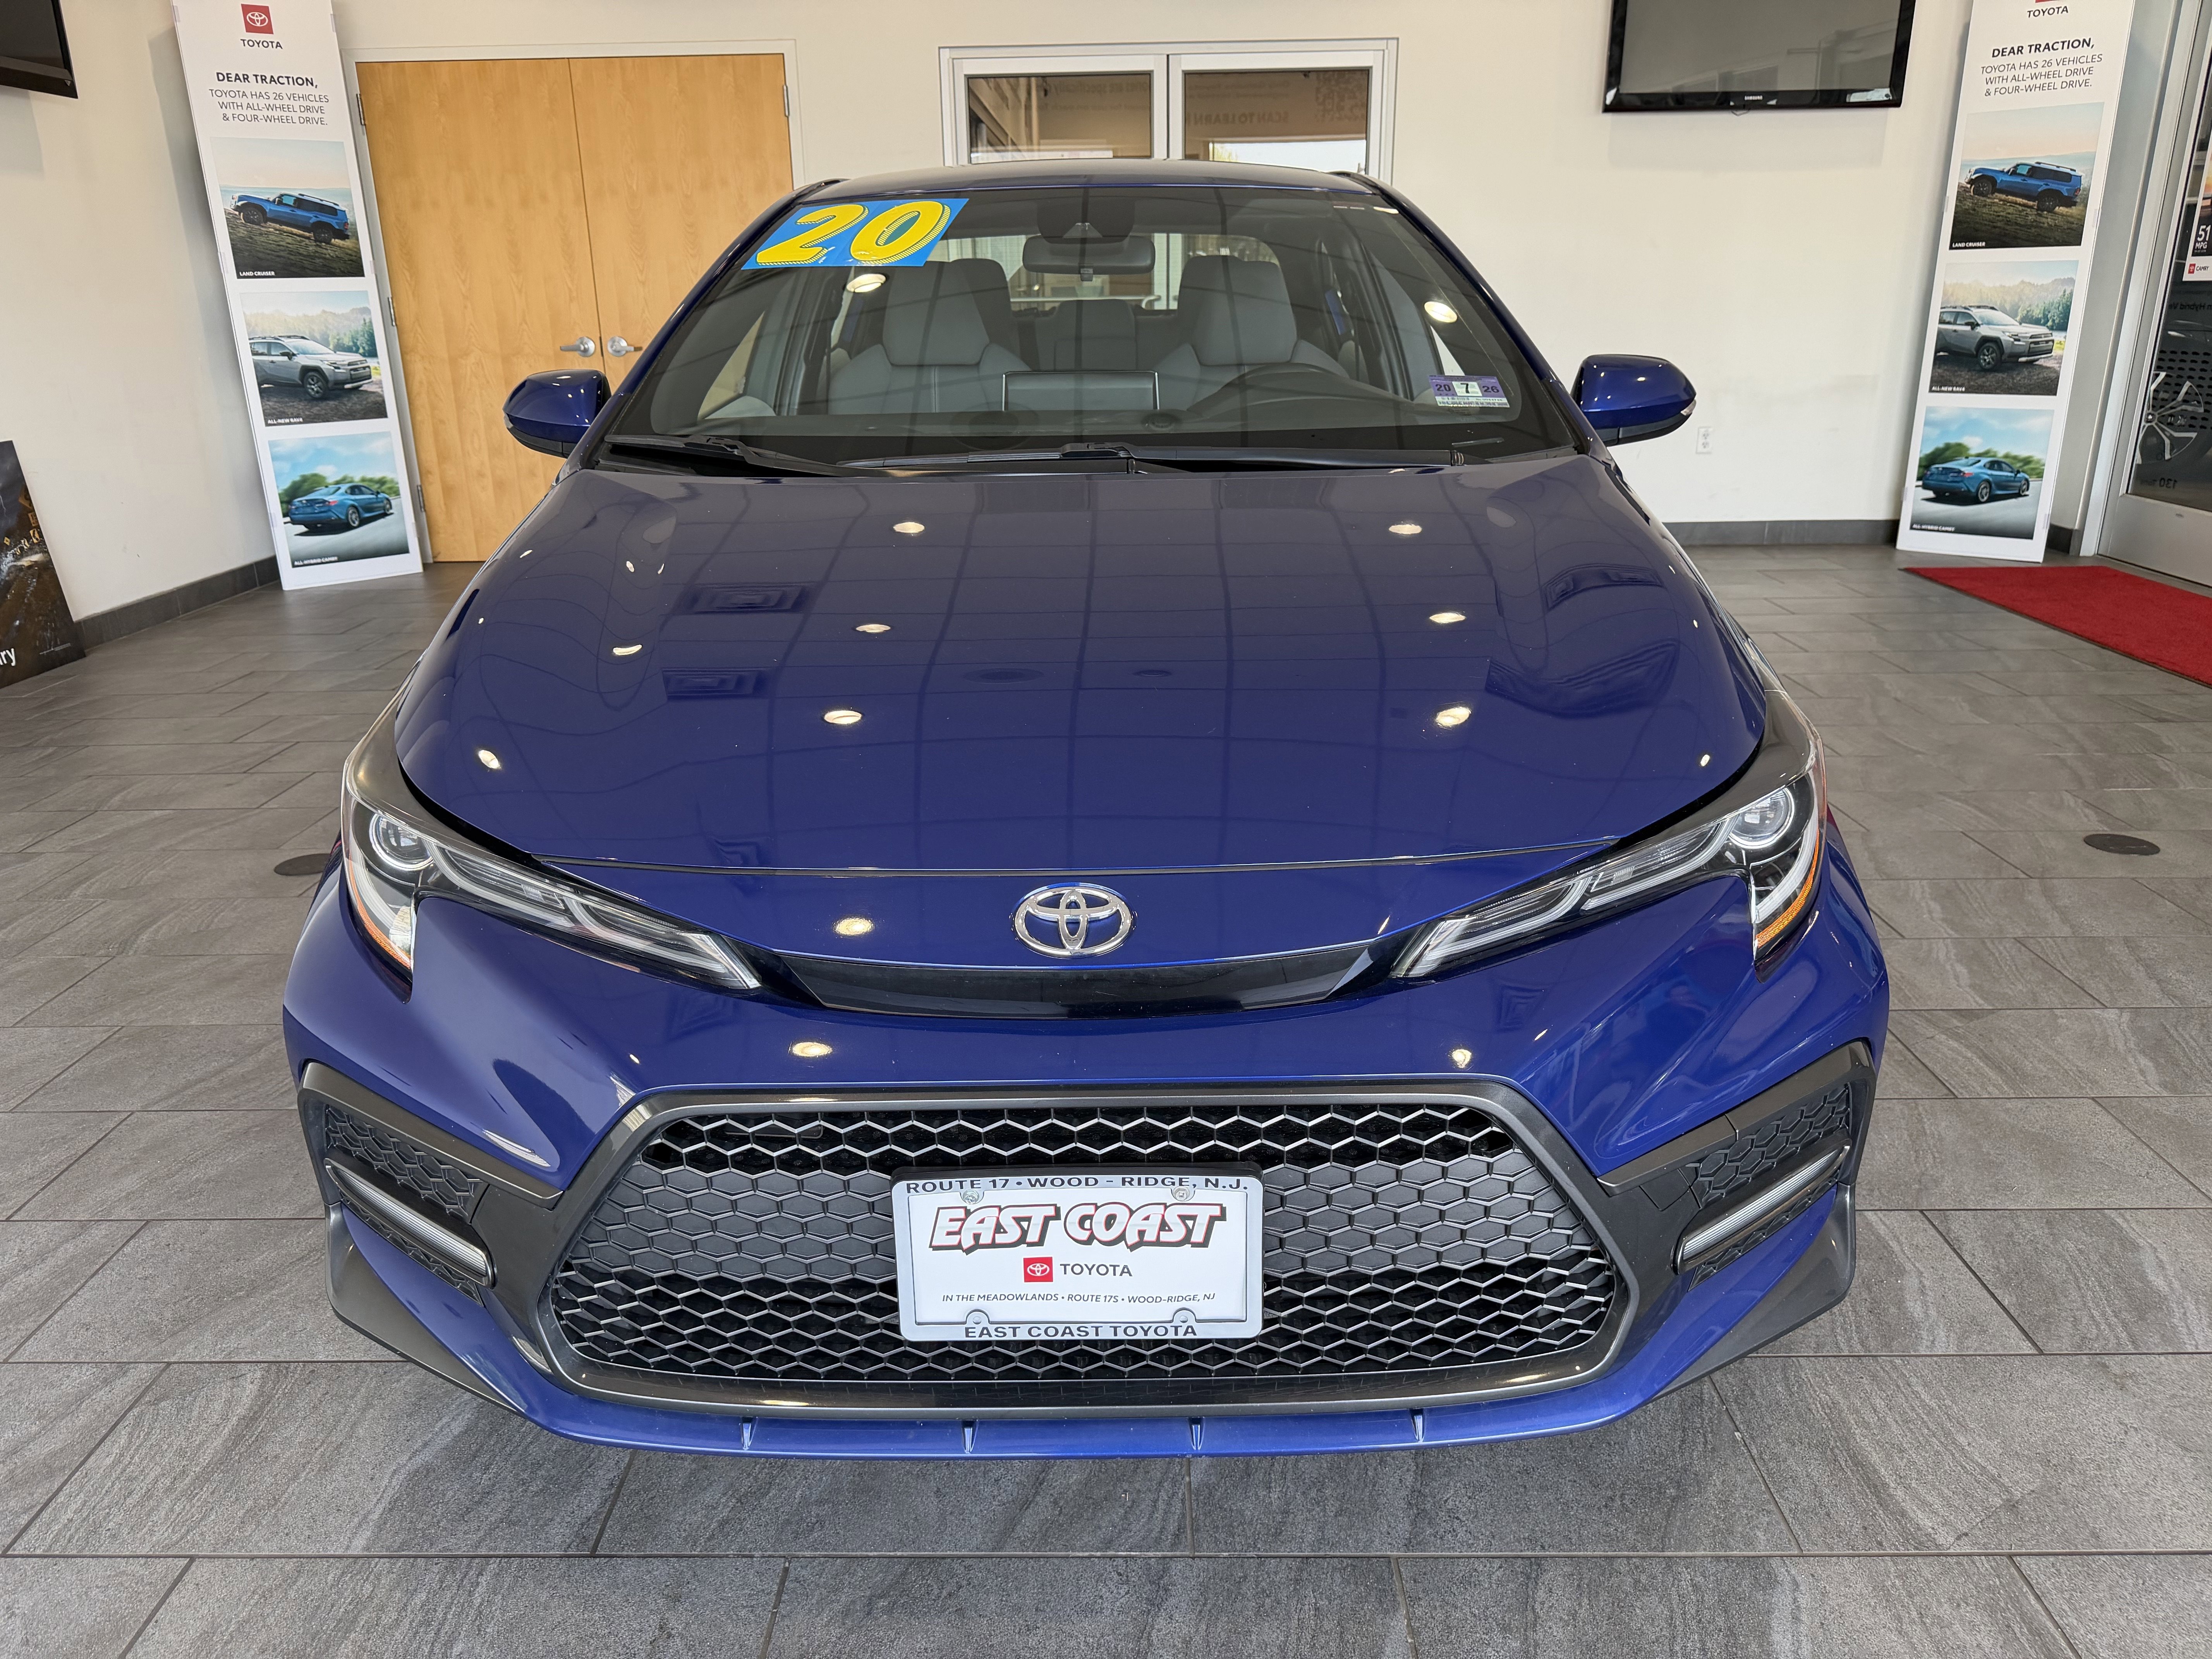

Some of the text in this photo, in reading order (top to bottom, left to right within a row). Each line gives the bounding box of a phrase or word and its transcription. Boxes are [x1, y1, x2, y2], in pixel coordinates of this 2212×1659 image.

[2027, 6, 2068, 18] TOYOTA
[240, 39, 283, 49] TOYOTA
[1992, 38, 2094, 58] DEAR TRACTION,
[1981, 54, 2102, 74] TOYOTA HAS 26 VEHICLES
[216, 72, 318, 88] DEAR TRACTION,
[1985, 67, 2094, 85] WITH ALL-WHEEL DRIVE
[1994, 82, 2057, 96] FOUR-WHEEL
[2061, 79, 2092, 89] DRIVE.
[209, 89, 329, 103] TOYOTA HAS 26 VEHICLES
[218, 101, 325, 113] WITH ALL-WHEEL DRIVE
[222, 113, 328, 125] & FOUR-WHEEL DRIVE.
[756, 201, 951, 266] 20
[2197, 225, 2211, 241] 51
[1460, 383, 1470, 394] 7
[906, 1180, 981, 1194] ROUTE
[989, 1179, 1010, 1188] 17
[1027, 1176, 1099, 1187] WOOD
[1121, 1176, 1197, 1188] RIDGE,
[1204, 1178, 1248, 1190] N.J.
[928, 1202, 1227, 1255] EAST COAST
[1060, 1263, 1133, 1277] TOYOTA
[977, 1293, 1059, 1301] MEADOWLANDS
[1067, 1294, 1101, 1302] ROUTE
[1103, 1295, 1119, 1303] 17S
[1128, 1294, 1200, 1303] WOOD-RIDGE,
[965, 1325, 1197, 1338] EAST COAST TOYOTA
